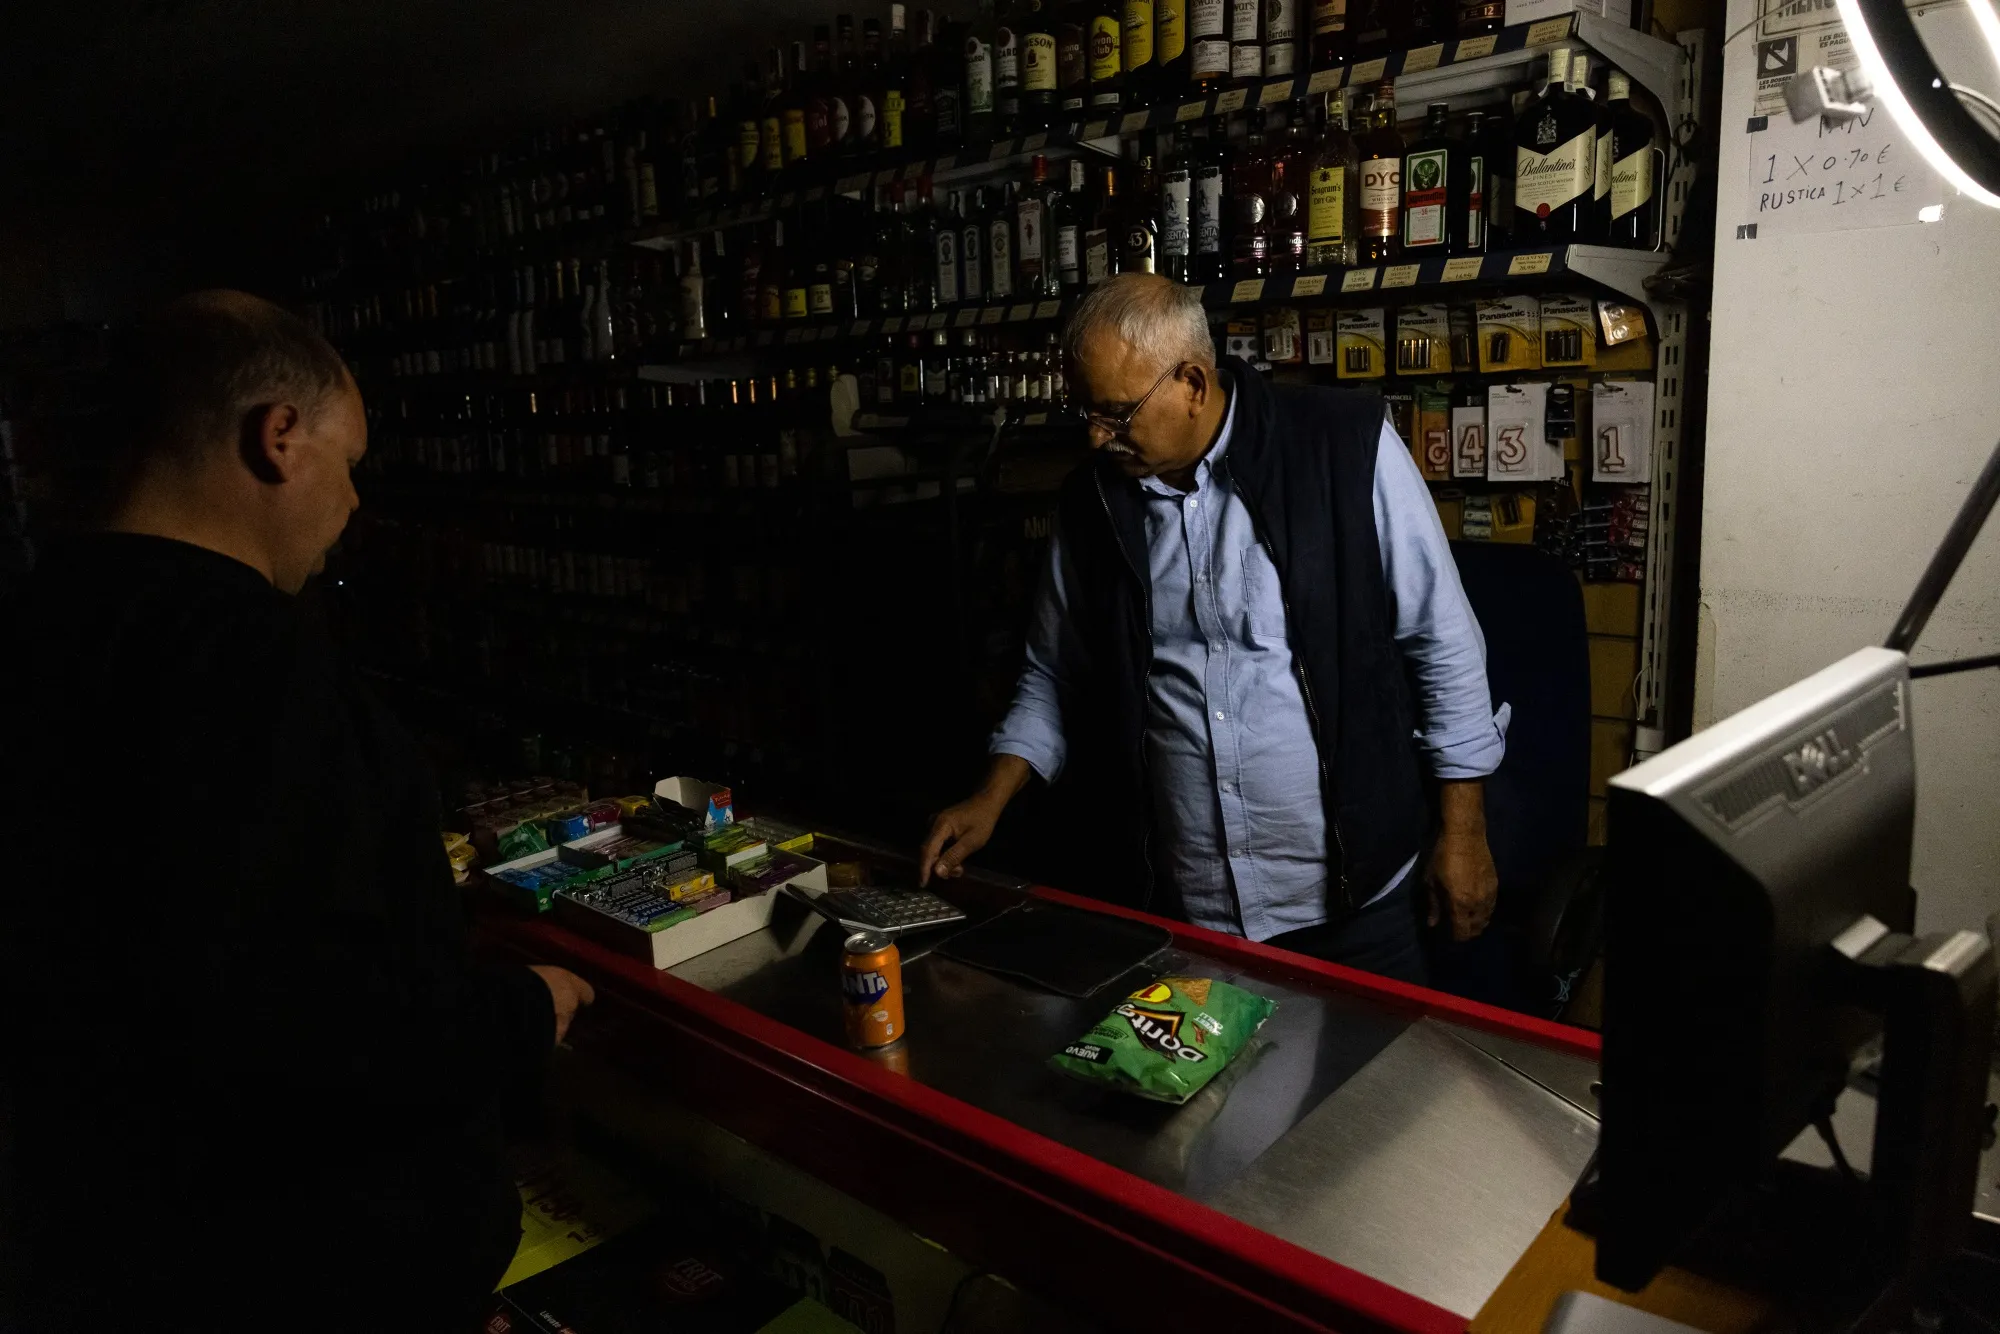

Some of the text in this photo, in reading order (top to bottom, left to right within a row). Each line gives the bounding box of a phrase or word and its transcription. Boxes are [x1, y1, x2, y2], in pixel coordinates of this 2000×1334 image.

[1517, 156, 1576, 178] Ballantine's
[1762, 154, 1776, 184] 1
[1365, 171, 1400, 188] DYC
[1311, 183, 1342, 195] Seagram's
[1128, 232, 1143, 247] 43
[1479, 309, 1525, 322] Panasonic
[1543, 305, 1589, 315] Panasonic
[1339, 320, 1380, 330] Panasonic
[1399, 316, 1438, 325] Panasonic
[1459, 425, 1485, 464] 4
[1499, 426, 1526, 466] 3
[1599, 426, 1625, 466] 1
[1065, 1045, 1099, 1060] NUEVO
